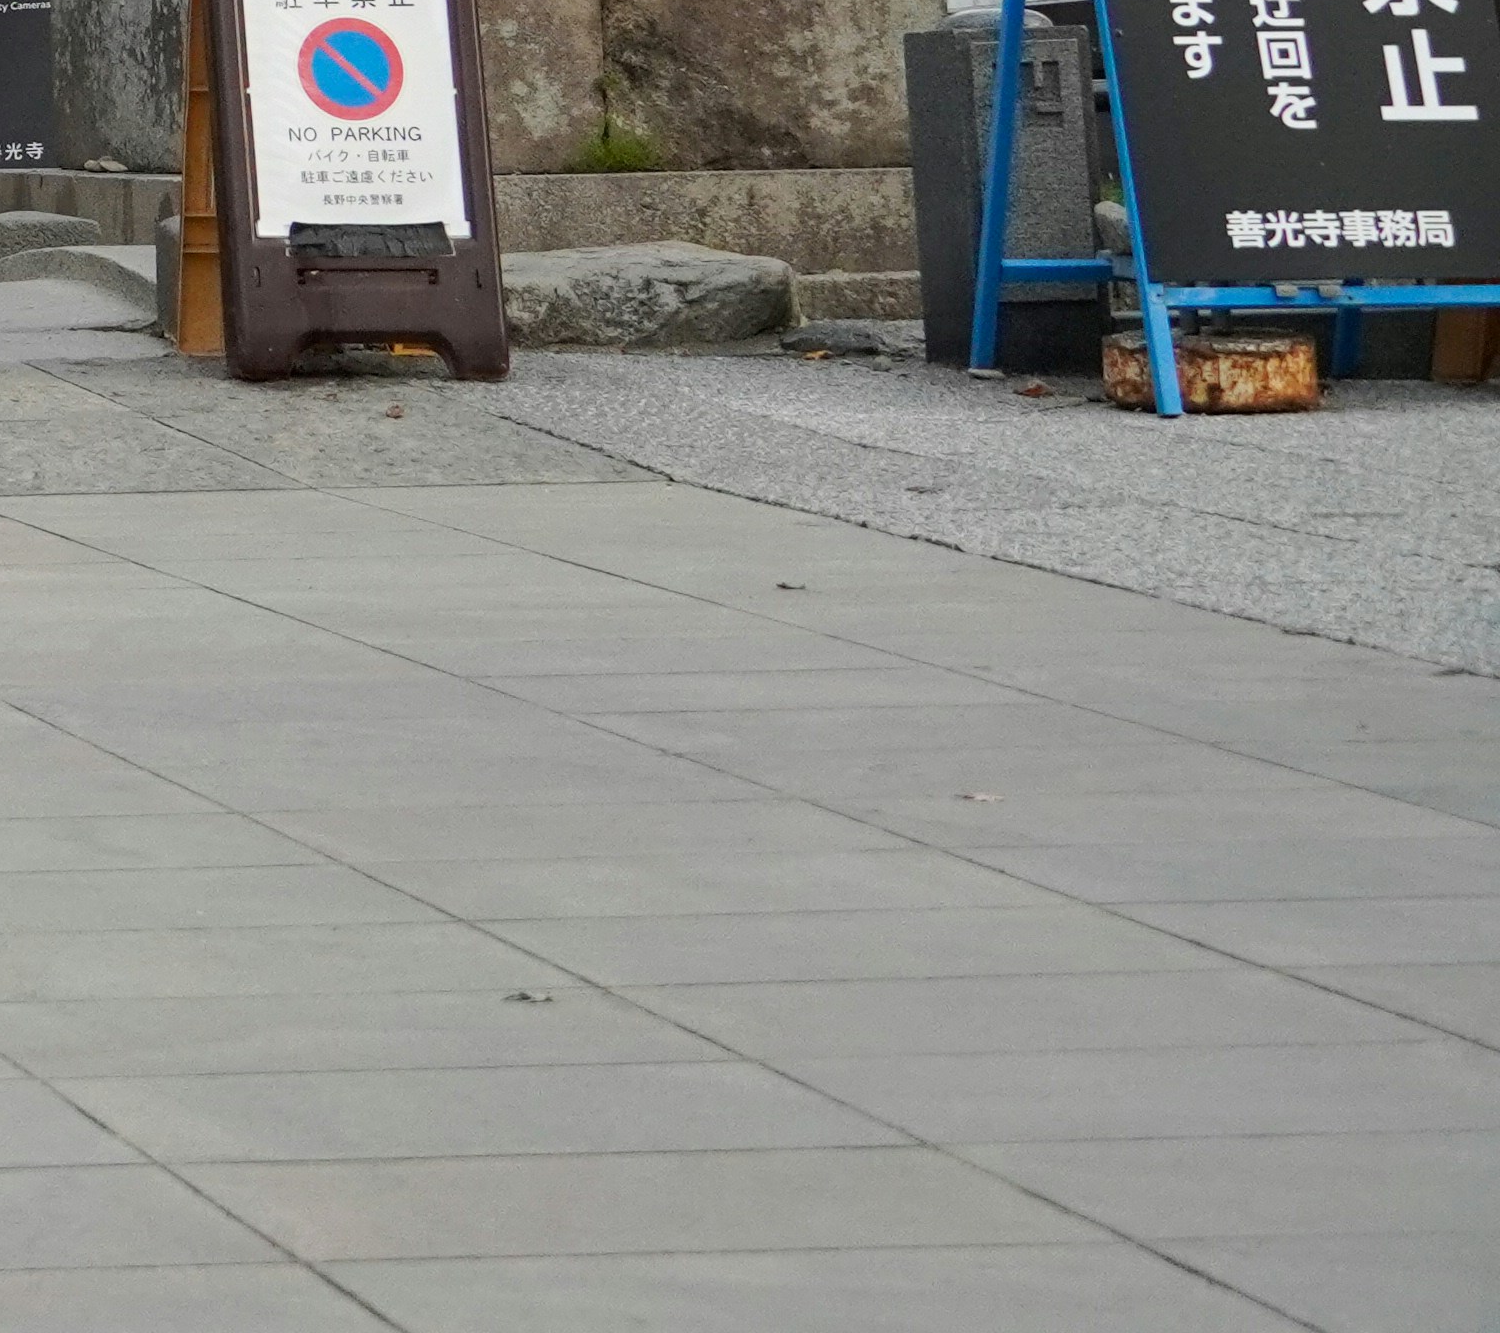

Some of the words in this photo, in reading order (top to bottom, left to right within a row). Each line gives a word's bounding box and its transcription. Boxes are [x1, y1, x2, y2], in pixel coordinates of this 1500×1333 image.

[10, 0, 51, 10] Cameras
[288, 127, 317, 142] NO
[331, 126, 422, 142] PARKING
[308, 149, 410, 163] バイク・自転車
[301, 169, 433, 184] 駐車ご遠慮ください
[323, 193, 404, 206] 長野中央警察署
[1225, 209, 1456, 248] 善光寺事務局
